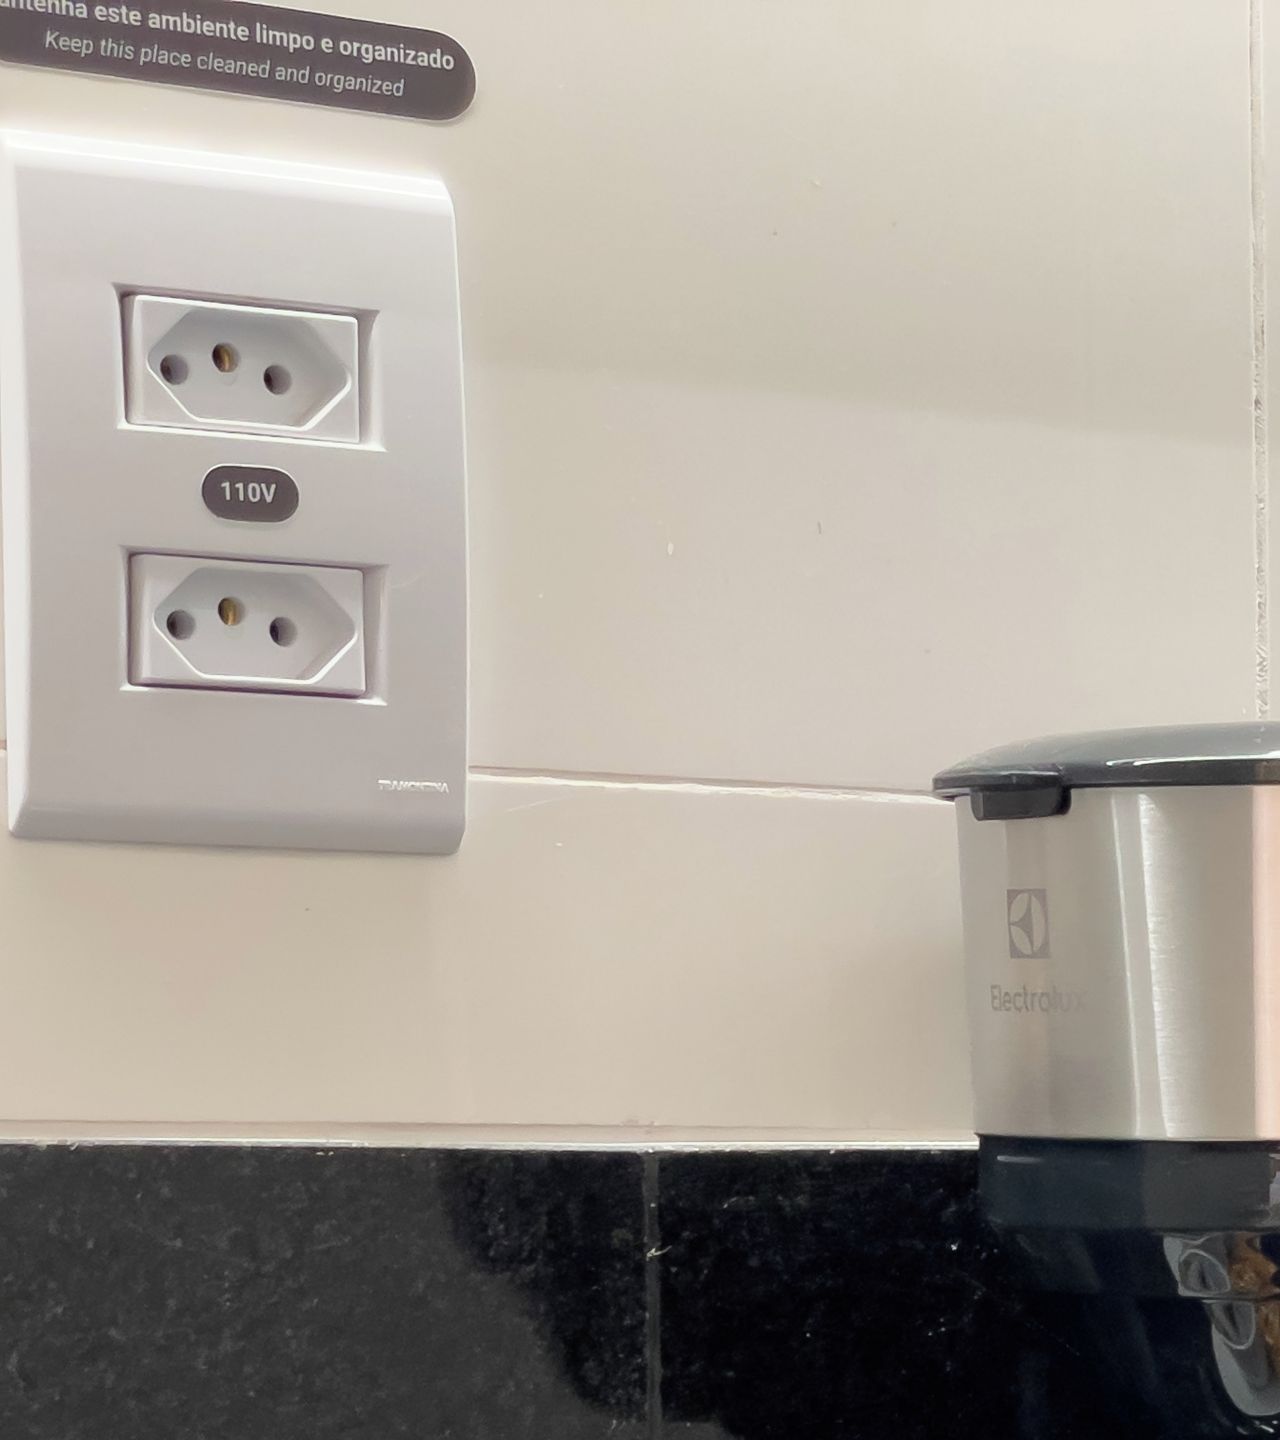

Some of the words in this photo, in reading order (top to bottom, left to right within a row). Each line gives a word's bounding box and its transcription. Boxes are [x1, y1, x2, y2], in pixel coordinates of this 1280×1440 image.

[45, 30, 94, 57] Keep
[100, 38, 134, 60] this
[139, 44, 191, 67] place
[197, 52, 270, 78] cleaned
[275, 66, 310, 84] and
[314, 71, 405, 97] organized
[94, 5, 141, 26] este
[148, 12, 249, 41] ambiente
[255, 22, 315, 53] limpo
[321, 38, 333, 52] e
[339, 41, 455, 70] organizado
[220, 481, 277, 504] 110V
